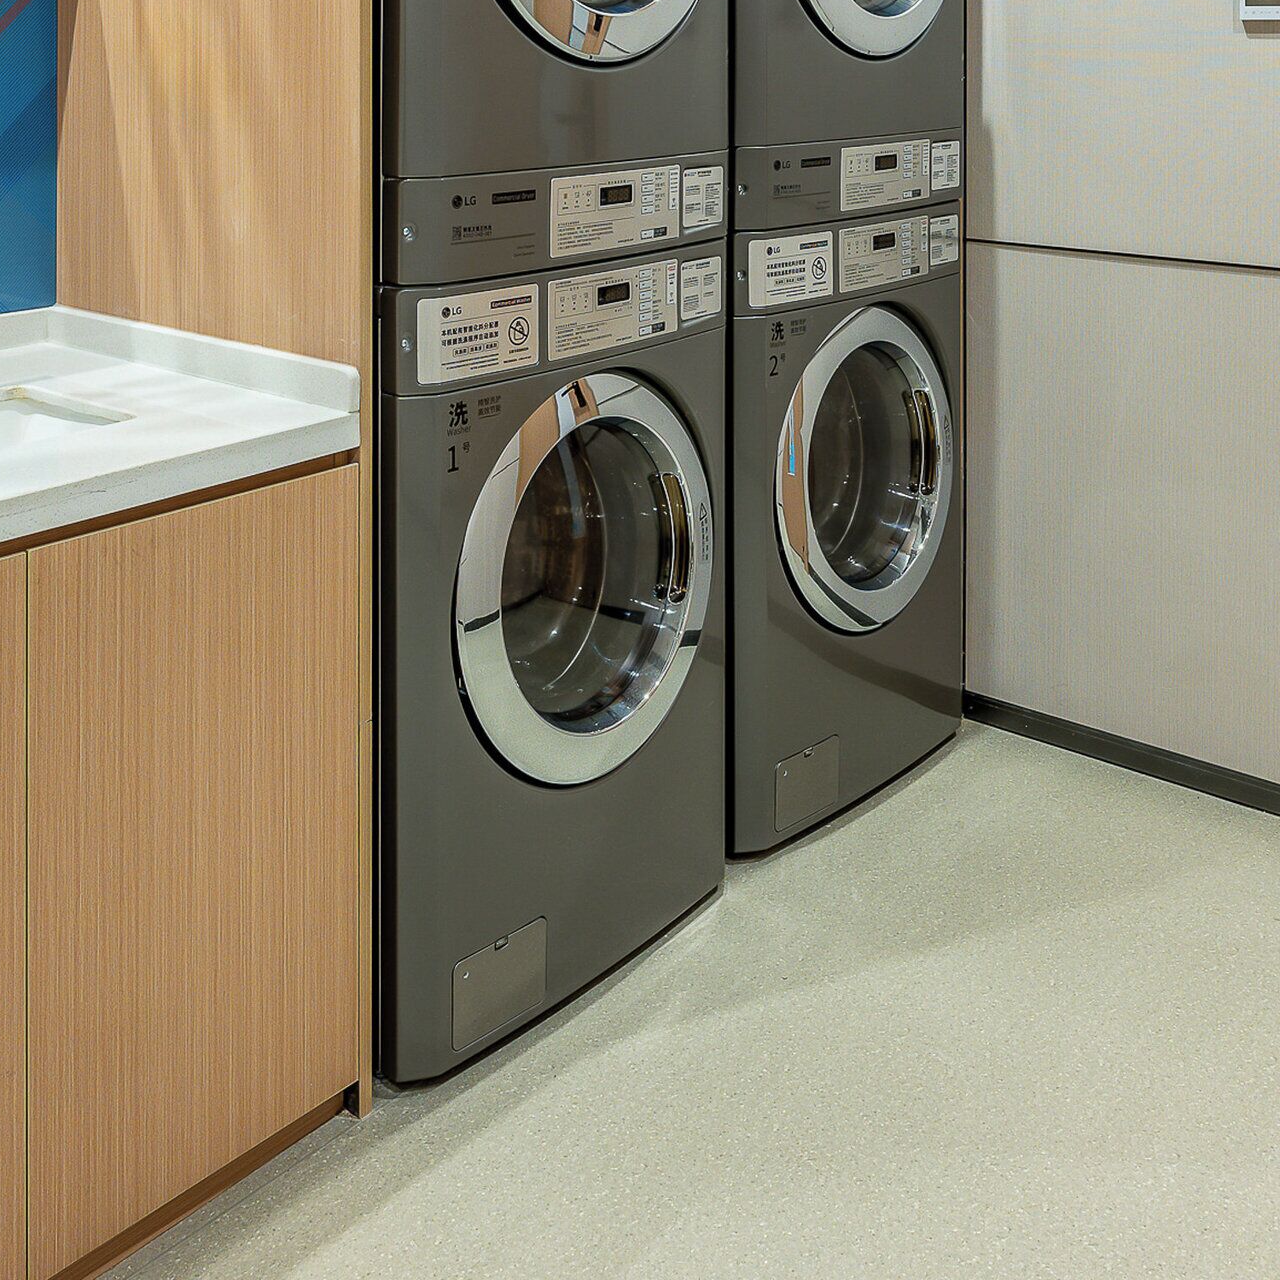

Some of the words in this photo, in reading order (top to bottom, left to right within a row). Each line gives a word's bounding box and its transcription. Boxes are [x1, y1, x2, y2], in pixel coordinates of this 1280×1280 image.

[782, 160, 791, 169] LG
[464, 195, 477, 207] LG
[773, 246, 781, 254] LG
[452, 306, 462, 316] LG
[771, 321, 784, 341] 洗
[449, 401, 468, 427] 洗
[447, 426, 472, 437] Washer
